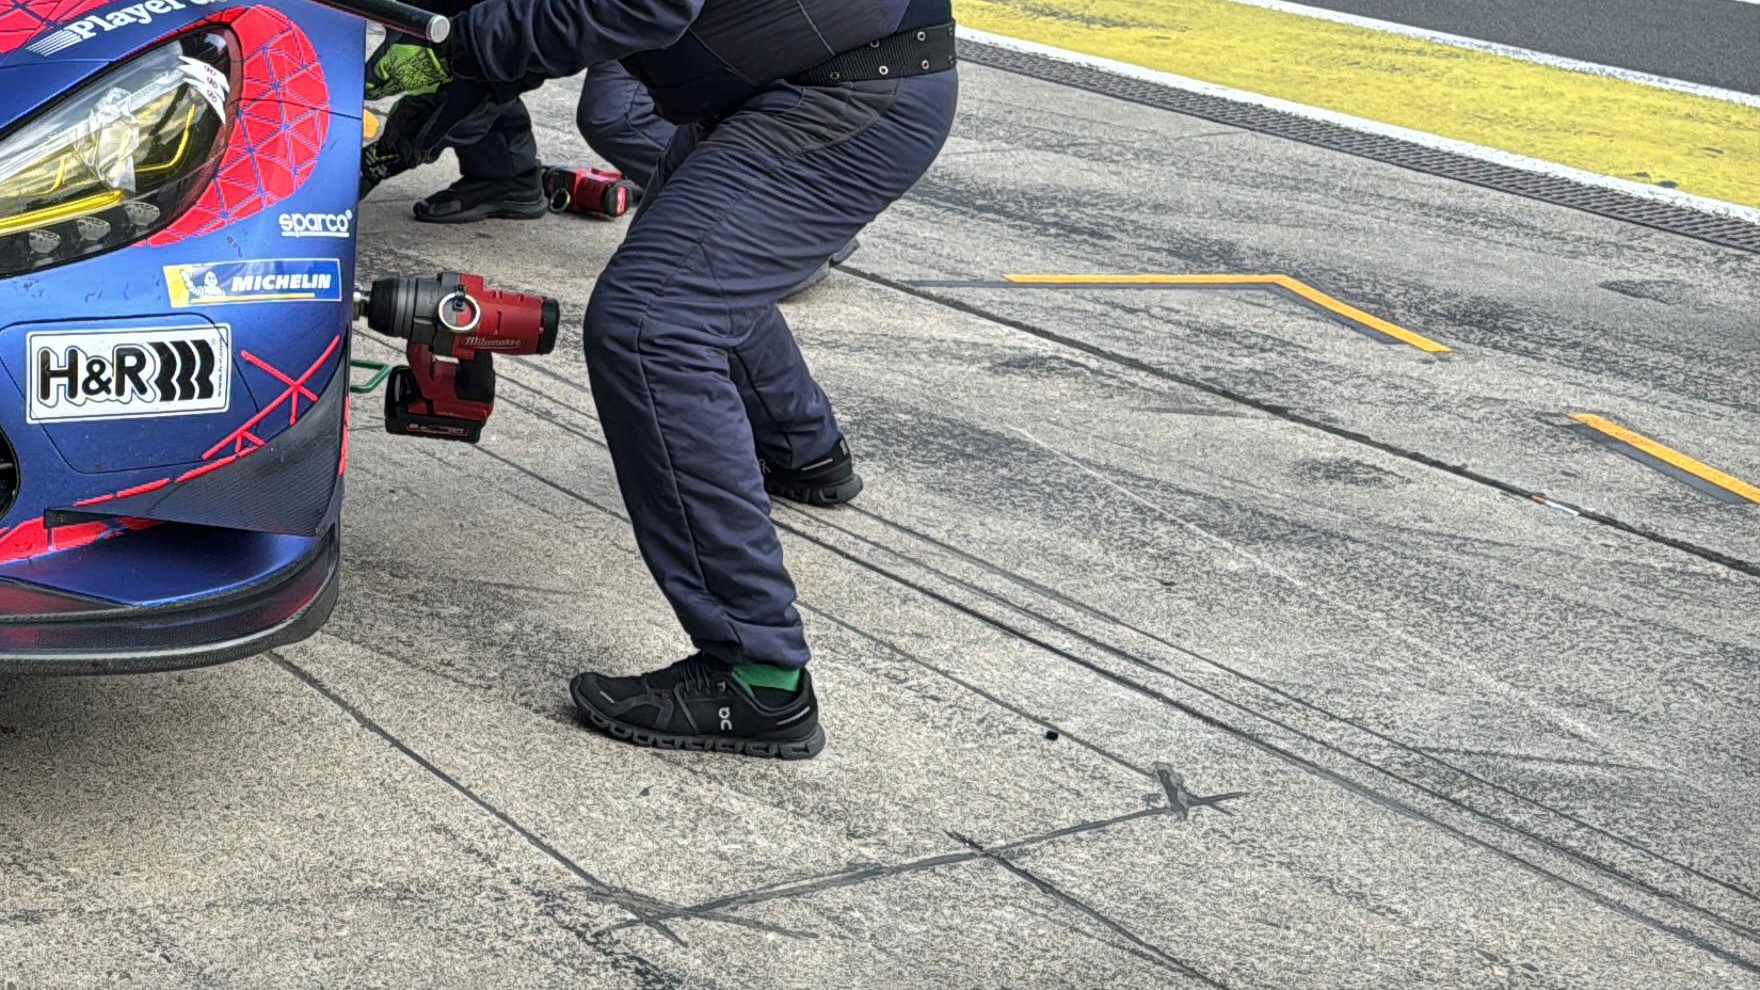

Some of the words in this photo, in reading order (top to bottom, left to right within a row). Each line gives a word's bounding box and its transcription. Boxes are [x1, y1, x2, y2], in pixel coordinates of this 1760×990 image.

[278, 211, 350, 237] sparco
[230, 273, 332, 292] MICHELIN
[40, 347, 148, 401] H&R
